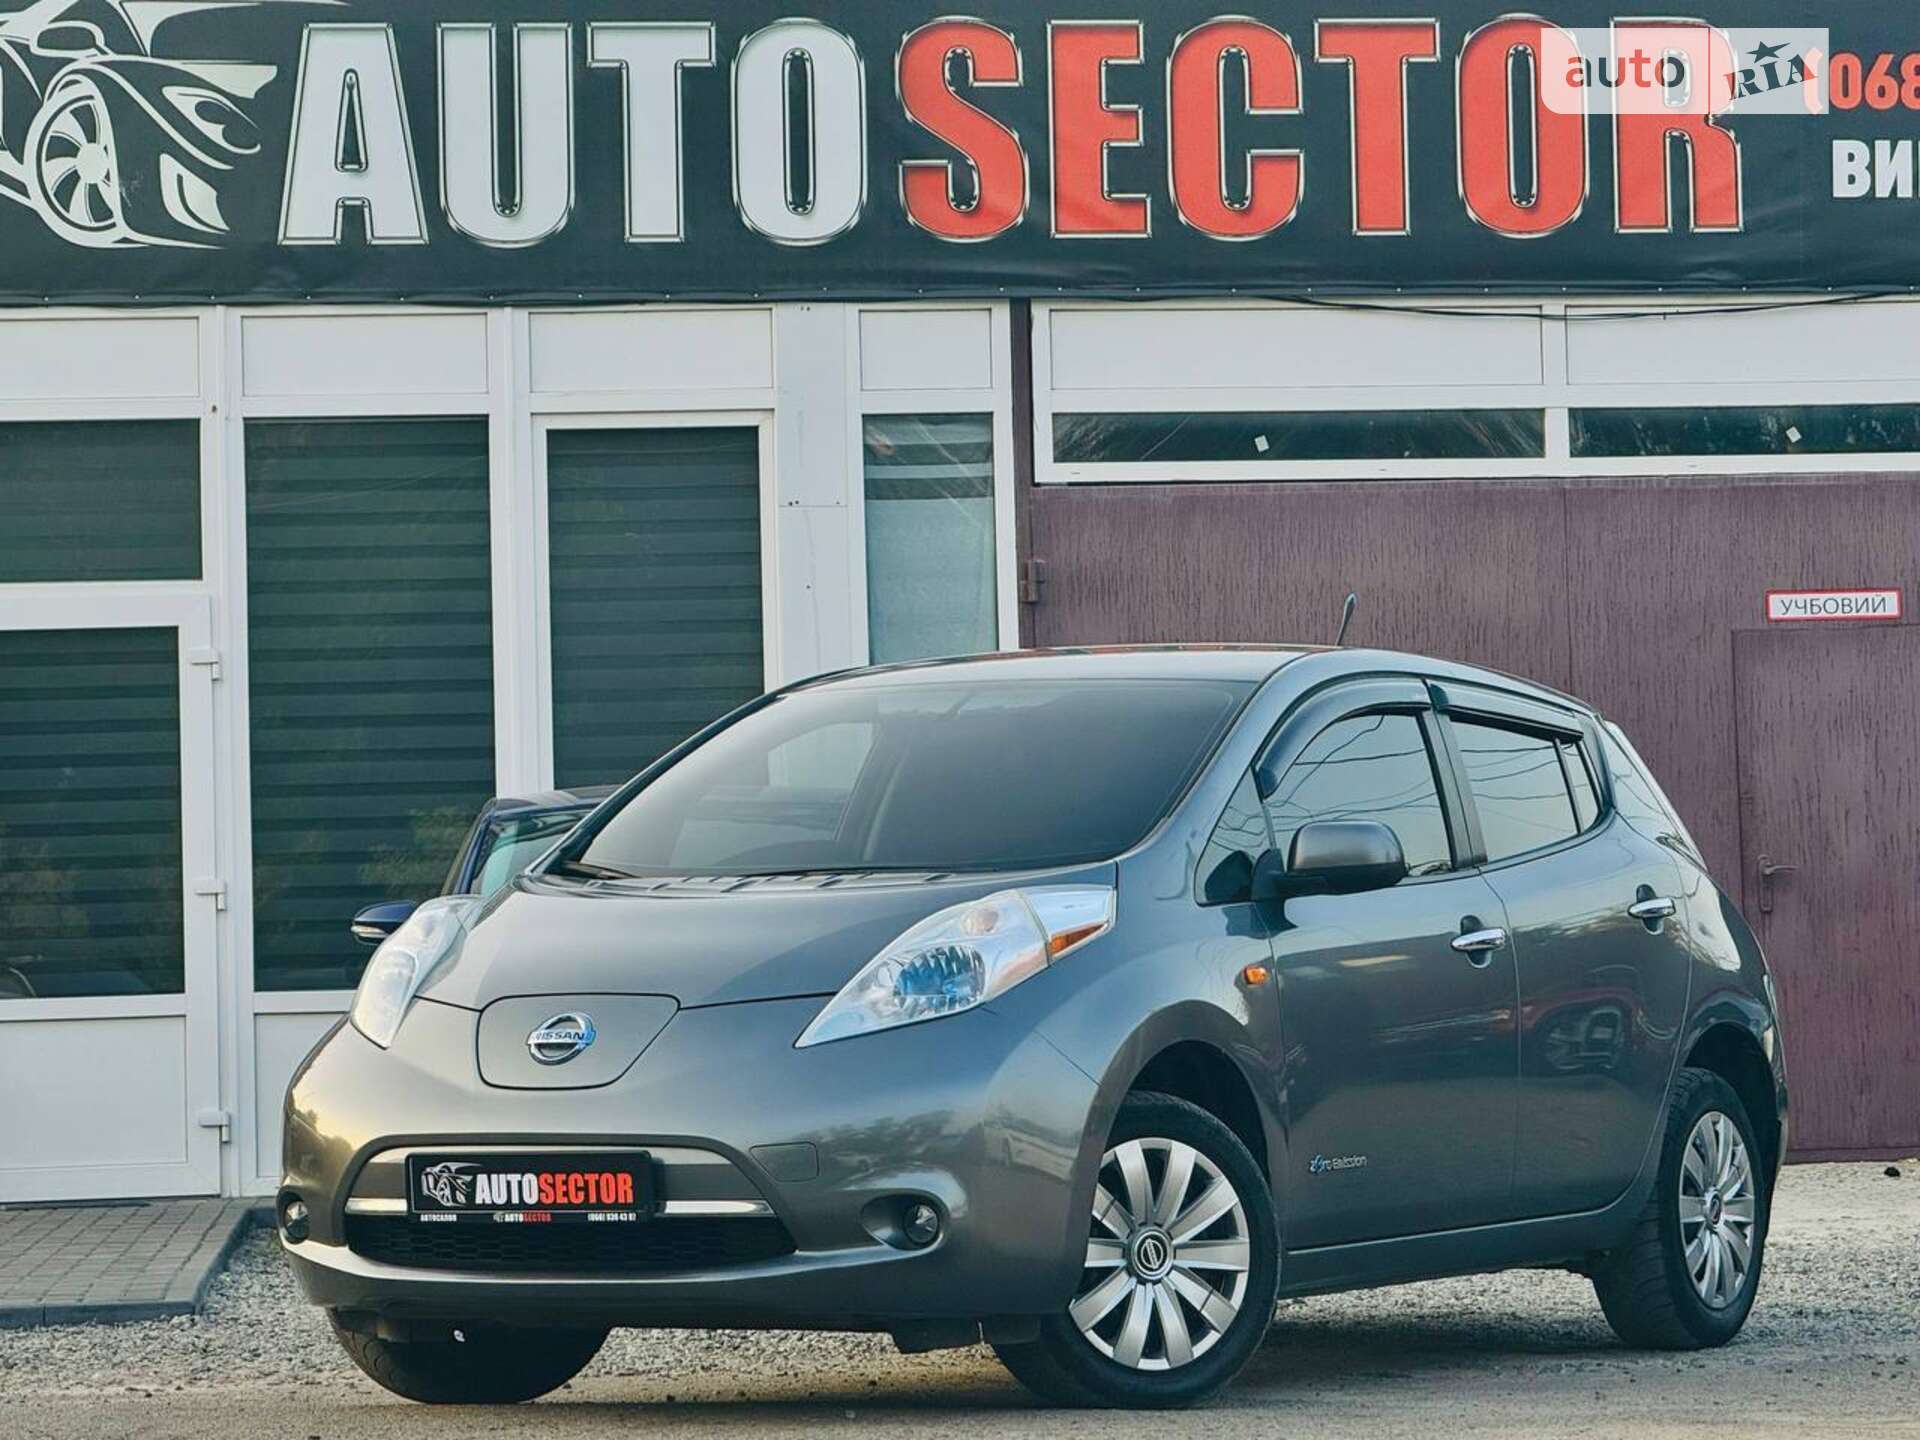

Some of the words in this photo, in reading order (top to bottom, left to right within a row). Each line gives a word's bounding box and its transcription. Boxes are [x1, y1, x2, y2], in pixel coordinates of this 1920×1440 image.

[277, 12, 1744, 247] AUTOSECTOR
[1832, 139, 1920, 198] ВИ
[1781, 593, 1887, 615] УЧБОВИЙ
[534, 1031, 585, 1041] NISSAN
[475, 1172, 634, 1205] AUTOSECTOR
